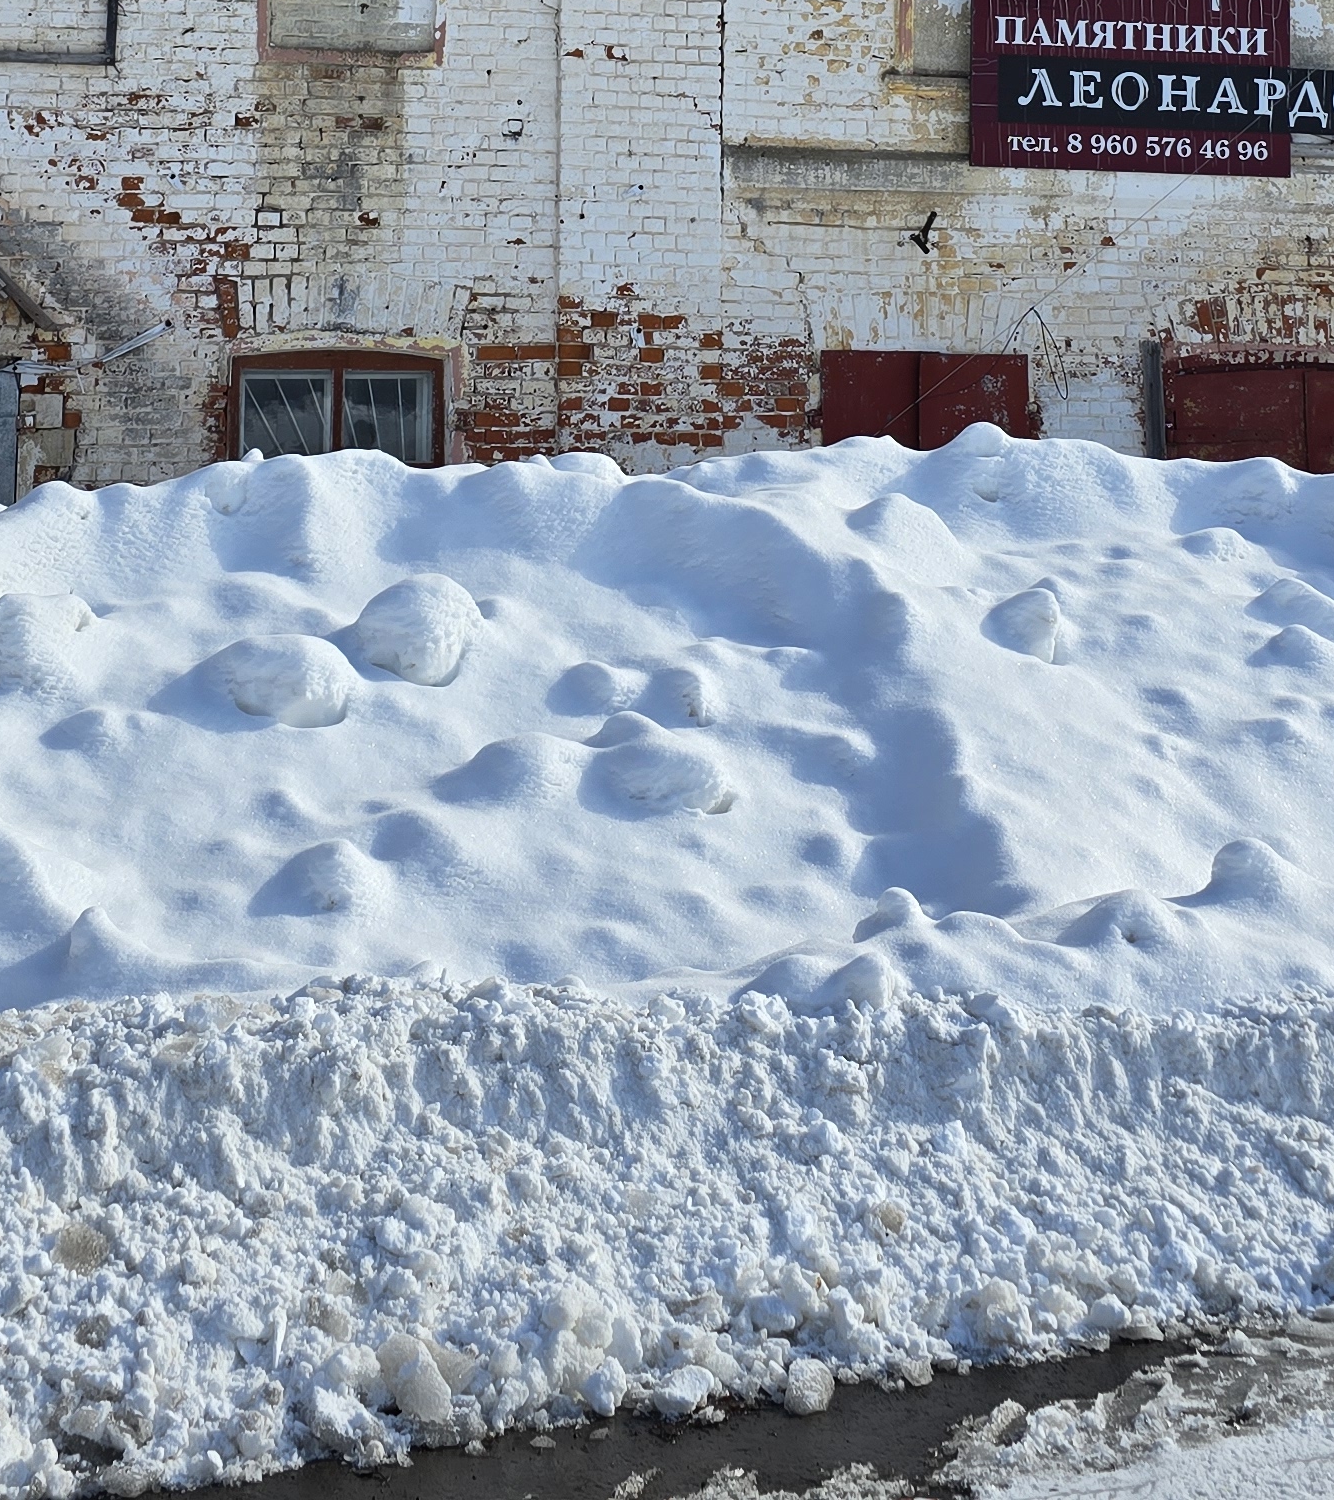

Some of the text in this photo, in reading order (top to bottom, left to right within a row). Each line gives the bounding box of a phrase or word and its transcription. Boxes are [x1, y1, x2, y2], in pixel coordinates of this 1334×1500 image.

[995, 15, 1267, 55] ПАМЯТНИКИ
[1008, 134, 1268, 160] тел. 8 960 576 46 96
